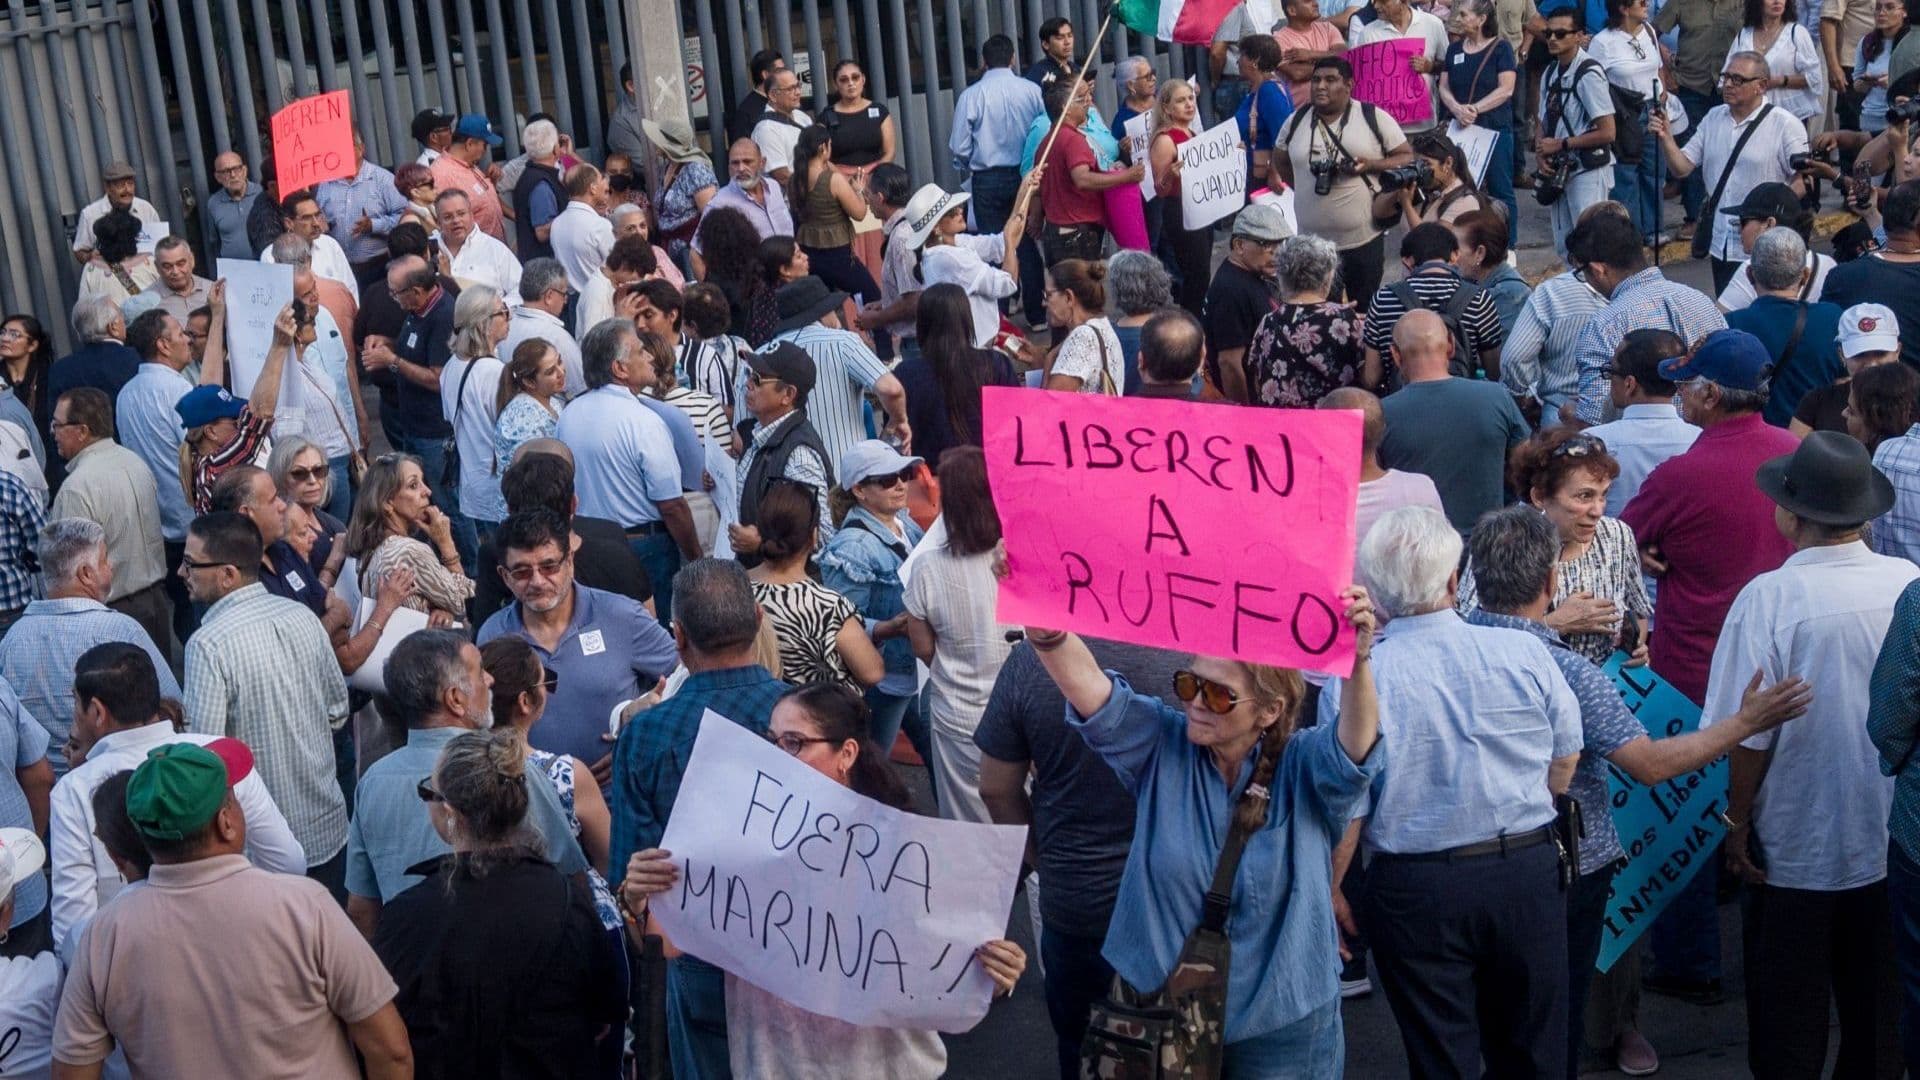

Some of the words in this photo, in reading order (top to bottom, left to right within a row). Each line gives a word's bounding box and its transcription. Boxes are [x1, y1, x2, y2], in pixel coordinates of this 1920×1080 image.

[273, 96, 341, 144] LIBEREN
[293, 133, 305, 157] A
[1182, 131, 1234, 170] MORENA
[1014, 416, 1294, 498] LIBEREN
[1145, 494, 1191, 556] A
[1061, 551, 1339, 656] RUFFO
[743, 770, 932, 913] FUERA
[1603, 788, 1730, 939] INMEDIAT
